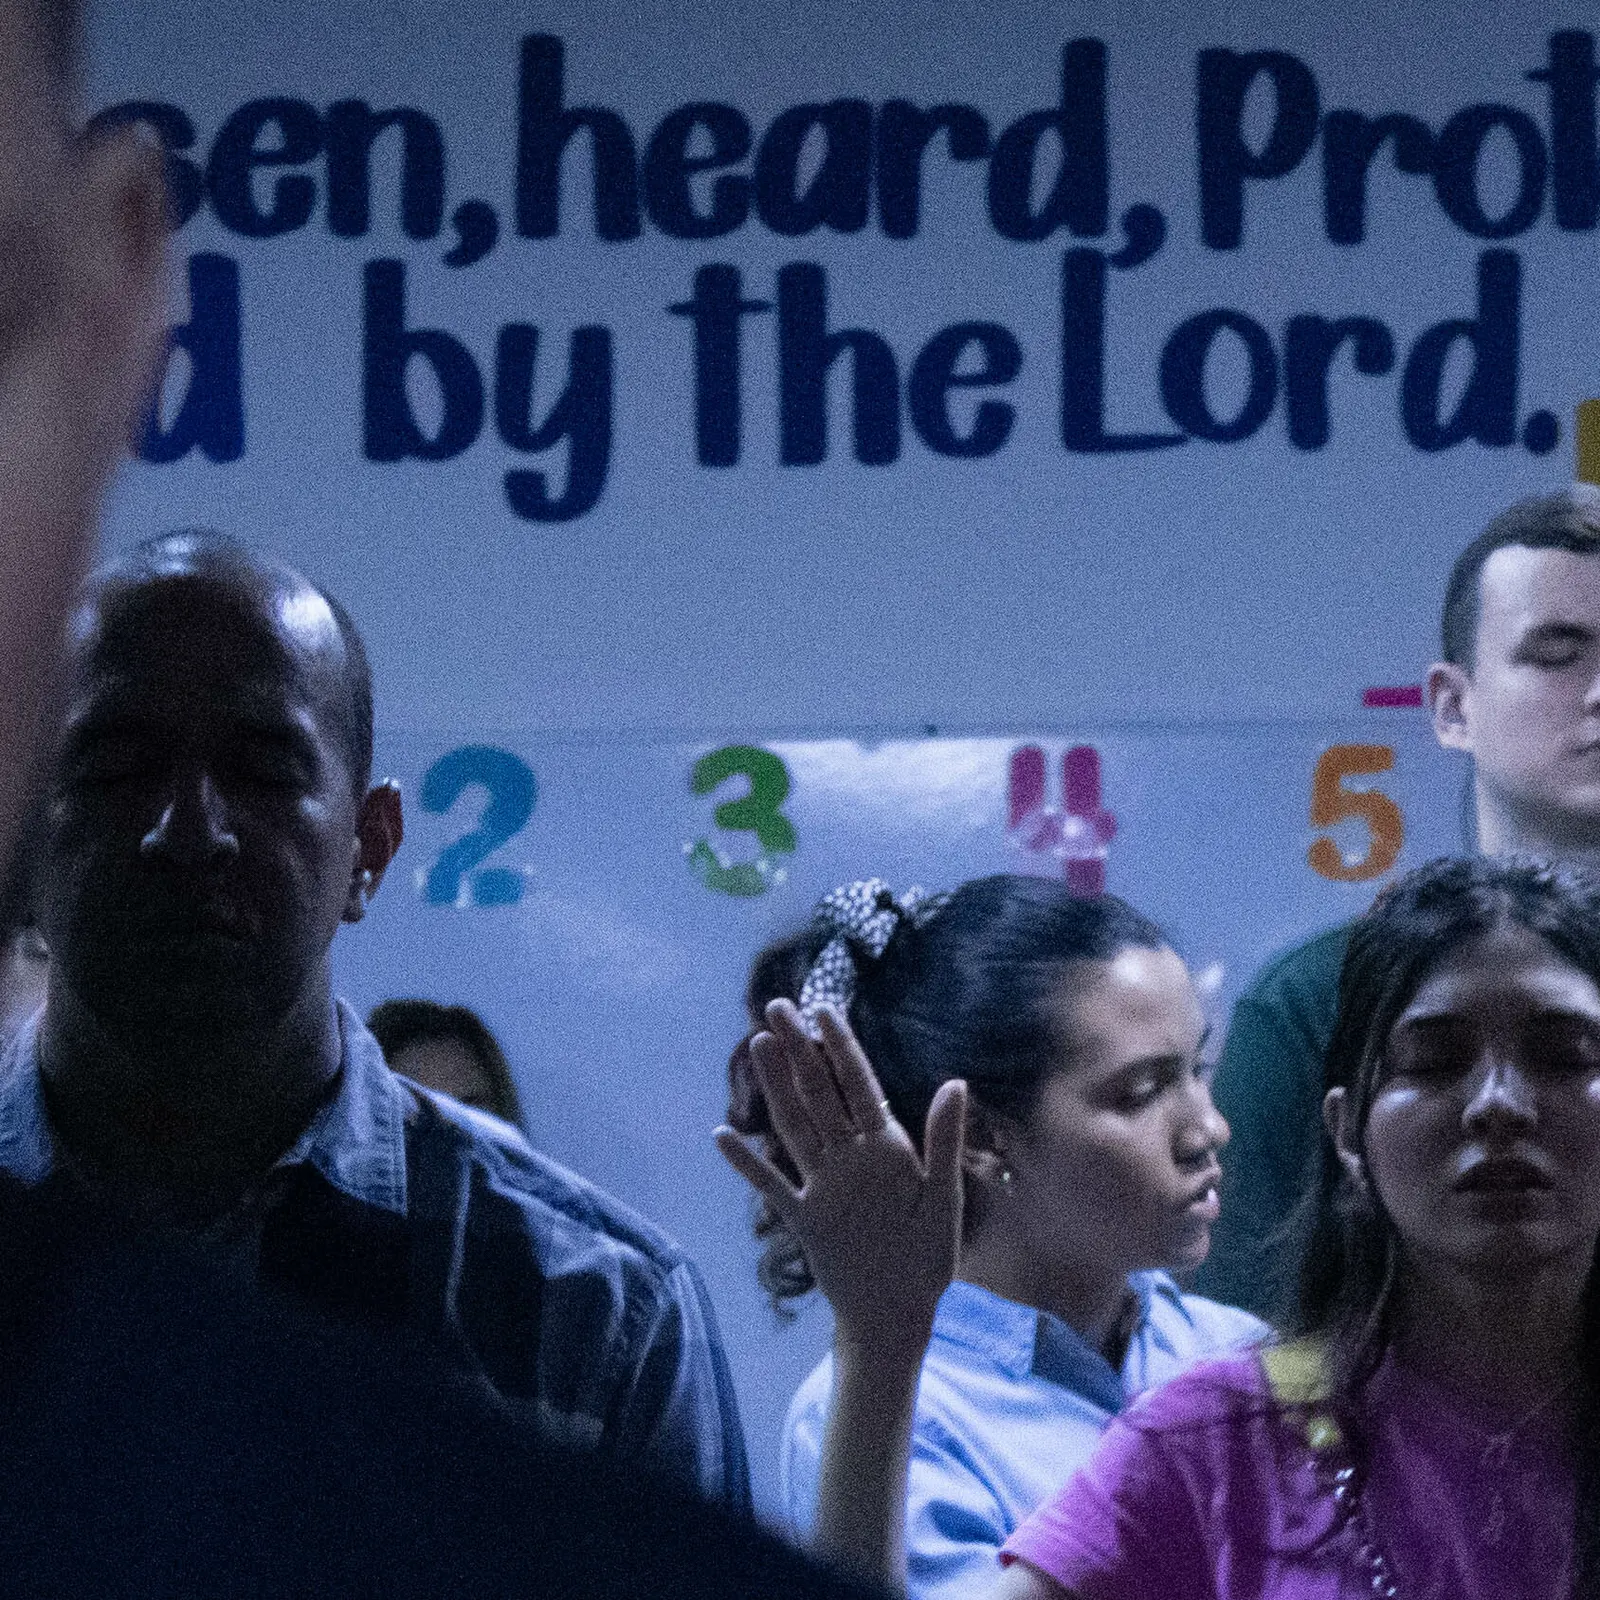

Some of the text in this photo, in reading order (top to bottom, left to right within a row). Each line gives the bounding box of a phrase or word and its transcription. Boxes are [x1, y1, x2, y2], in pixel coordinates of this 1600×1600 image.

[515, 33, 1168, 268] heard,
[363, 258, 613, 521] by
[668, 262, 1022, 467] the
[1060, 248, 1560, 453] Lord.
[420, 744, 537, 908] 2
[689, 744, 798, 898] 3
[1007, 744, 1118, 902] 4
[1307, 744, 1409, 884] 5
